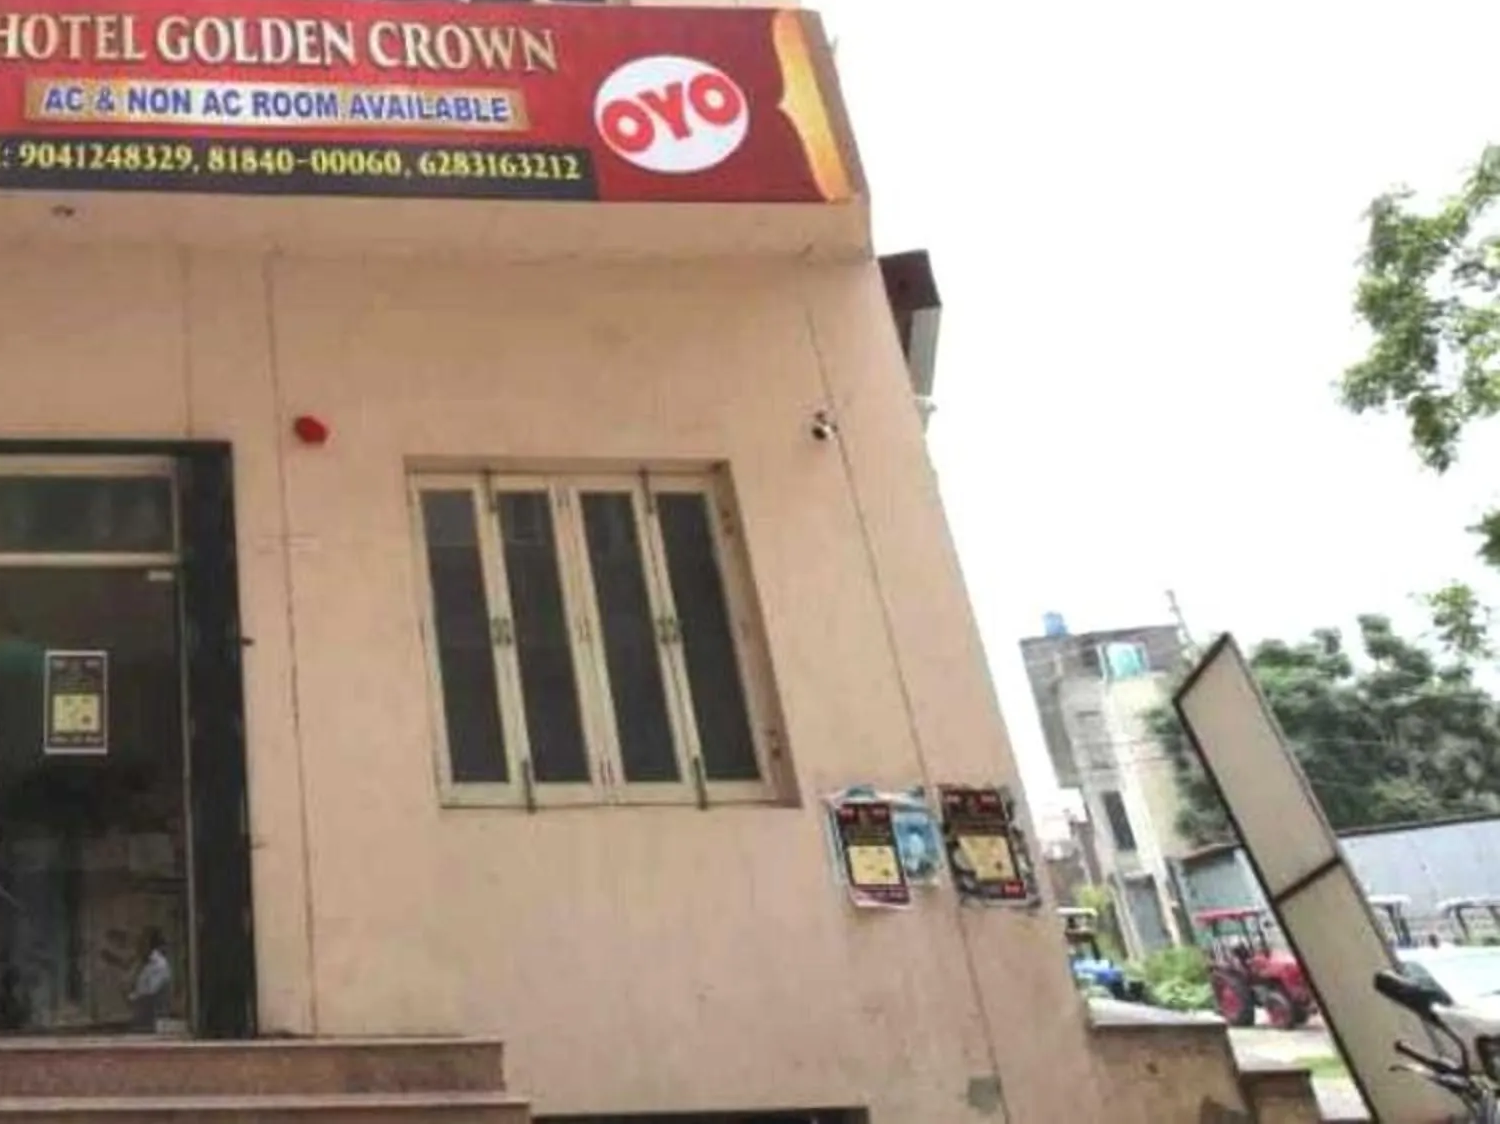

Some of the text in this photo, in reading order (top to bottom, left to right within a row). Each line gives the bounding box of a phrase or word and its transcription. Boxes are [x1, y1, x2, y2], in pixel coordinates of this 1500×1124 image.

[156, 15, 358, 69] GOLDEN
[369, 19, 560, 73] CROWN
[44, 88, 510, 123] AC & NON AC ROOM AVAILABLE
[600, 72, 742, 154] OYO
[18, 142, 201, 174] 9041248329,
[418, 150, 583, 180] 6283163212
